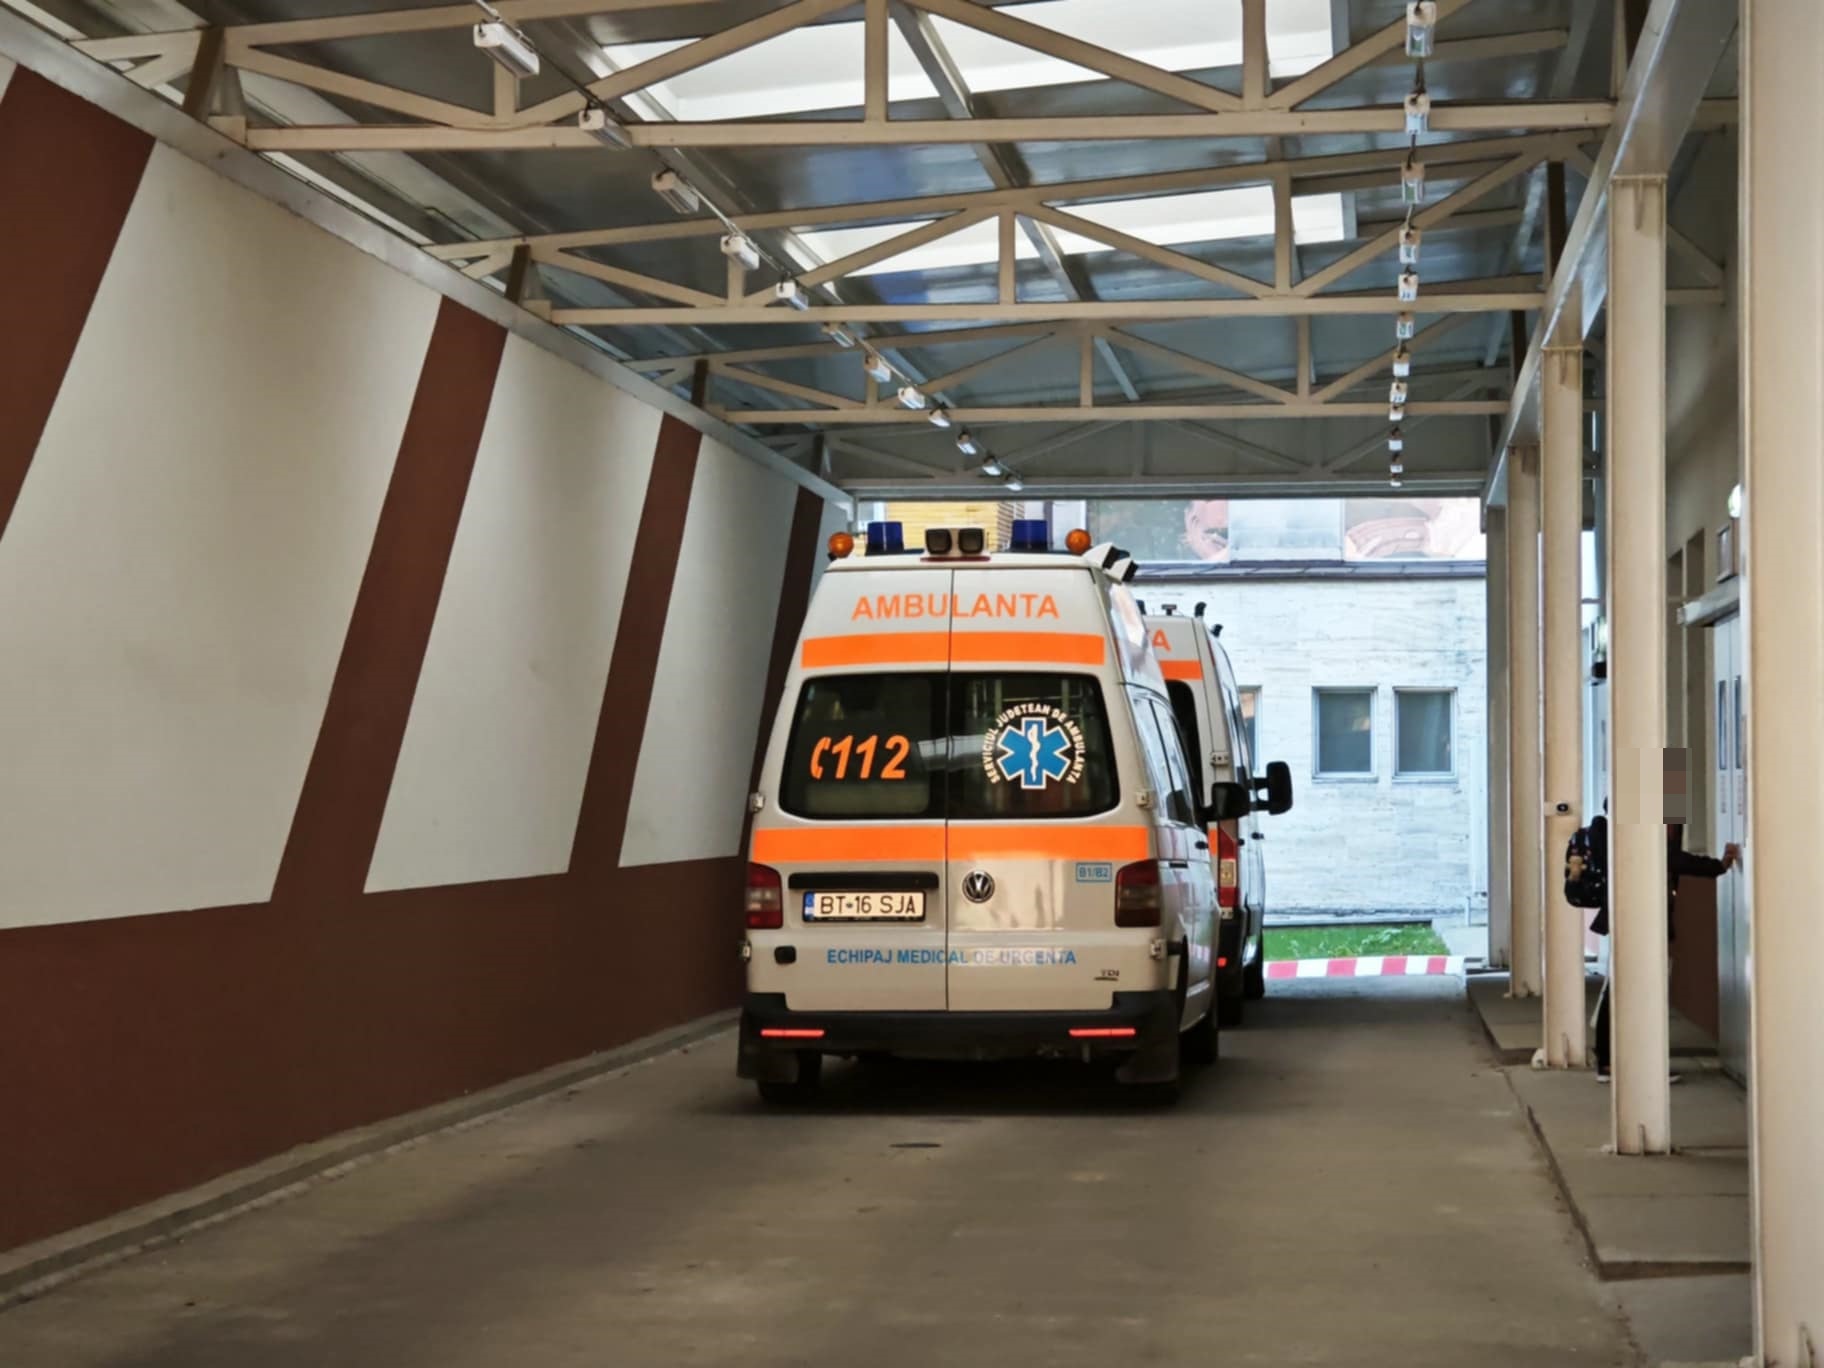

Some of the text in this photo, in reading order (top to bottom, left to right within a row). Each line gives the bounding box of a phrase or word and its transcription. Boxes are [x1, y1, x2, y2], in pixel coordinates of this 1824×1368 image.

[851, 592, 1060, 621] AMBULANTA
[831, 734, 910, 779] 112
[982, 703, 1086, 784] SERVICIUL JUDETEAN DE AMBULANTA
[879, 895, 916, 914] SJA
[827, 949, 1077, 964] ECHIPAJ MEDICAL DE URGENTA
